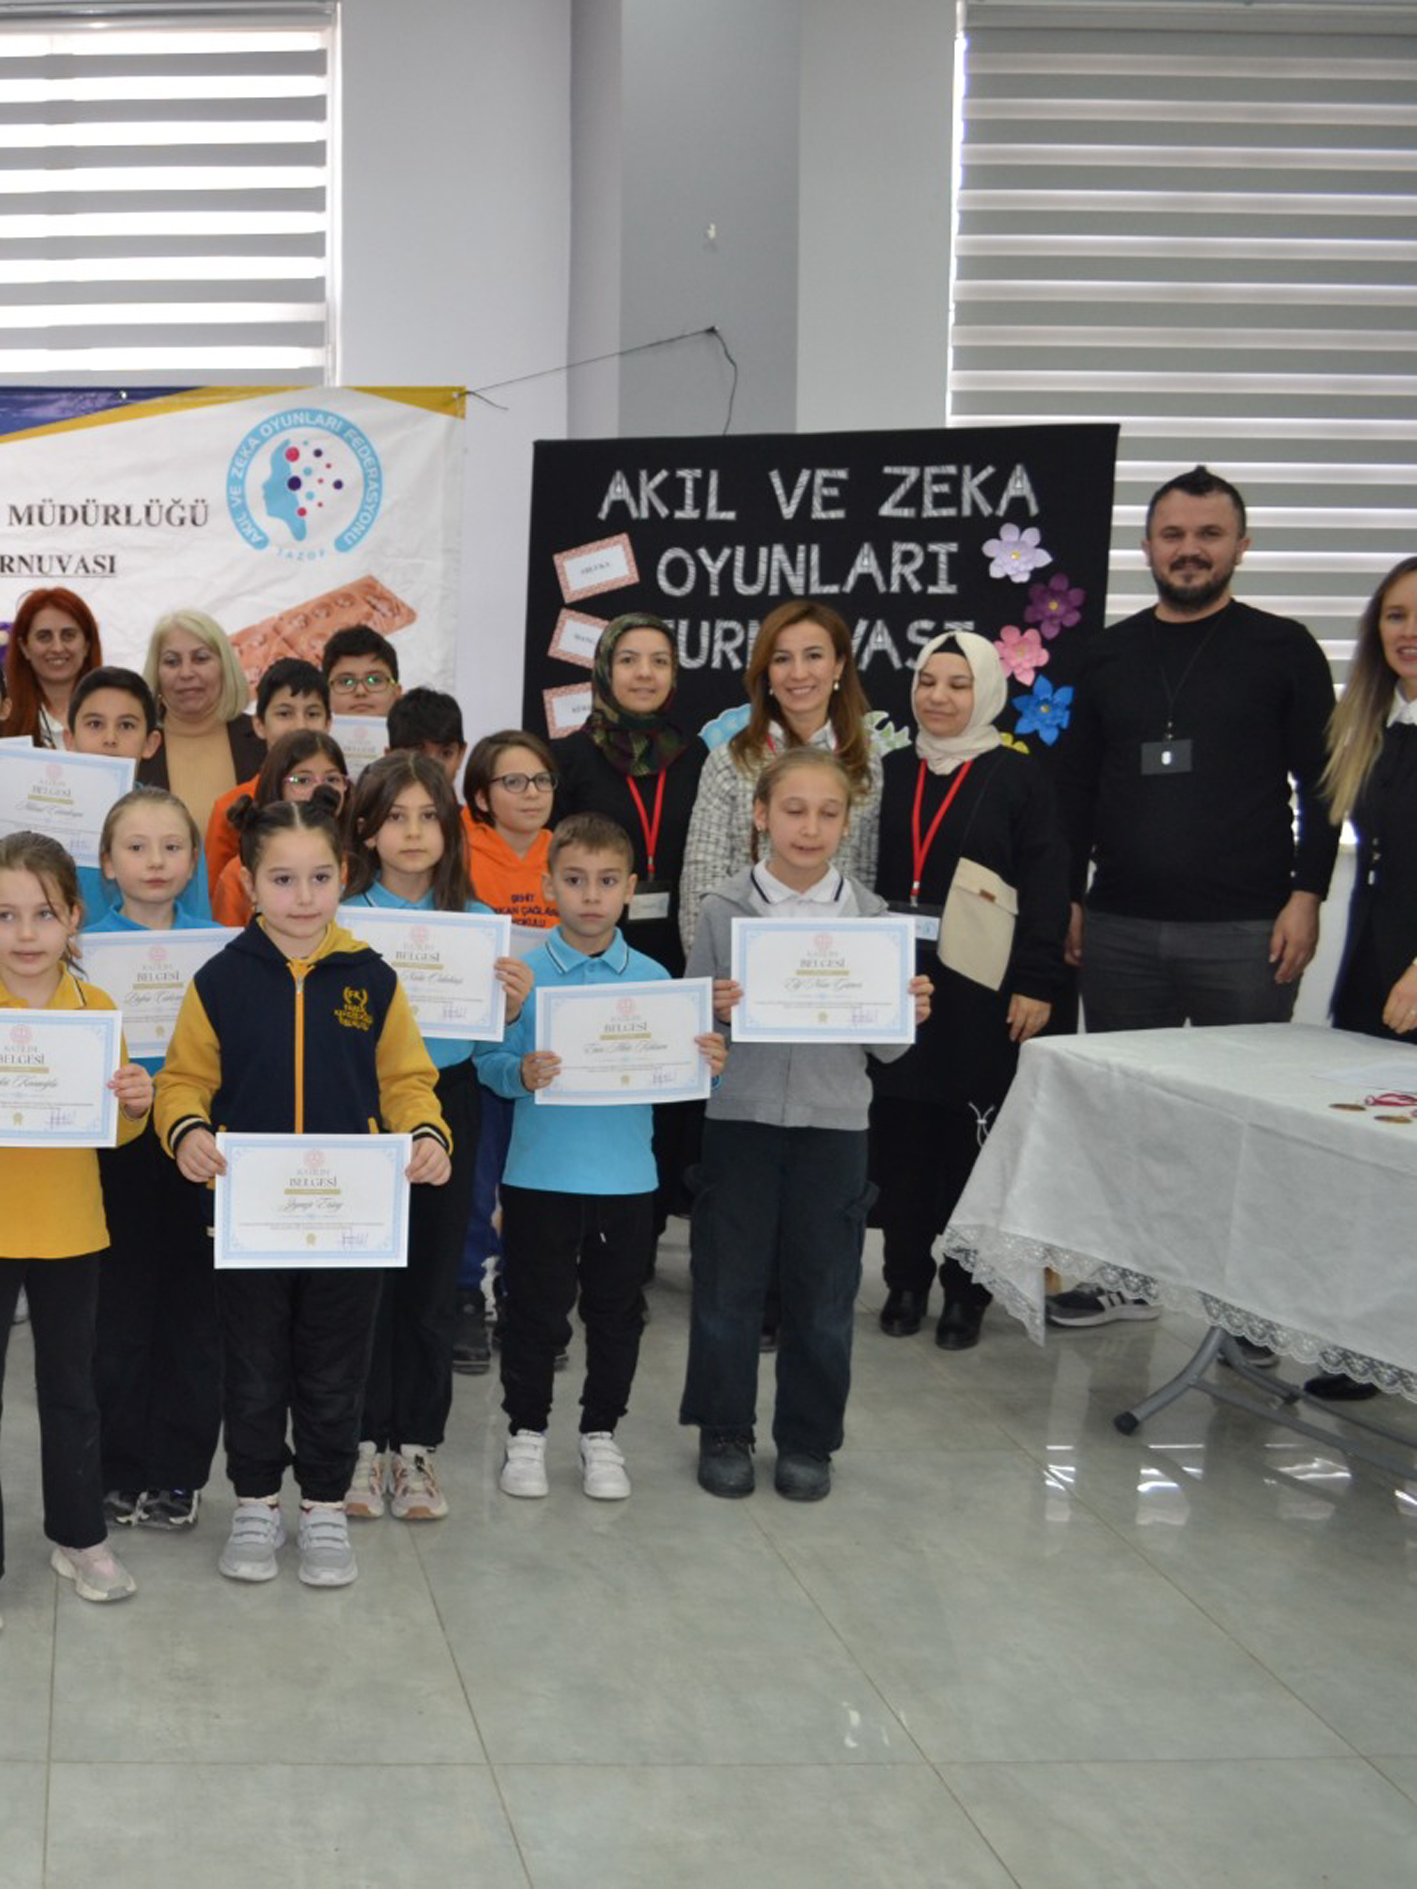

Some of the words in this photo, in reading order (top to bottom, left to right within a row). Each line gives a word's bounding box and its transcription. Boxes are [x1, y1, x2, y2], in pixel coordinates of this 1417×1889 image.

[259, 411, 343, 437] OYUNLARI
[232, 438, 261, 480] ZEKA
[229, 485, 243, 507] VE
[343, 428, 380, 545] FEDERASYONU
[596, 468, 738, 521] AKIL
[769, 467, 850, 520] VE
[878, 463, 1040, 518] ZEKA
[8, 498, 209, 527] MÜDÜRLÜĞÜ
[236, 511, 266, 544] AKIL
[656, 540, 959, 597] OYUNLARI
